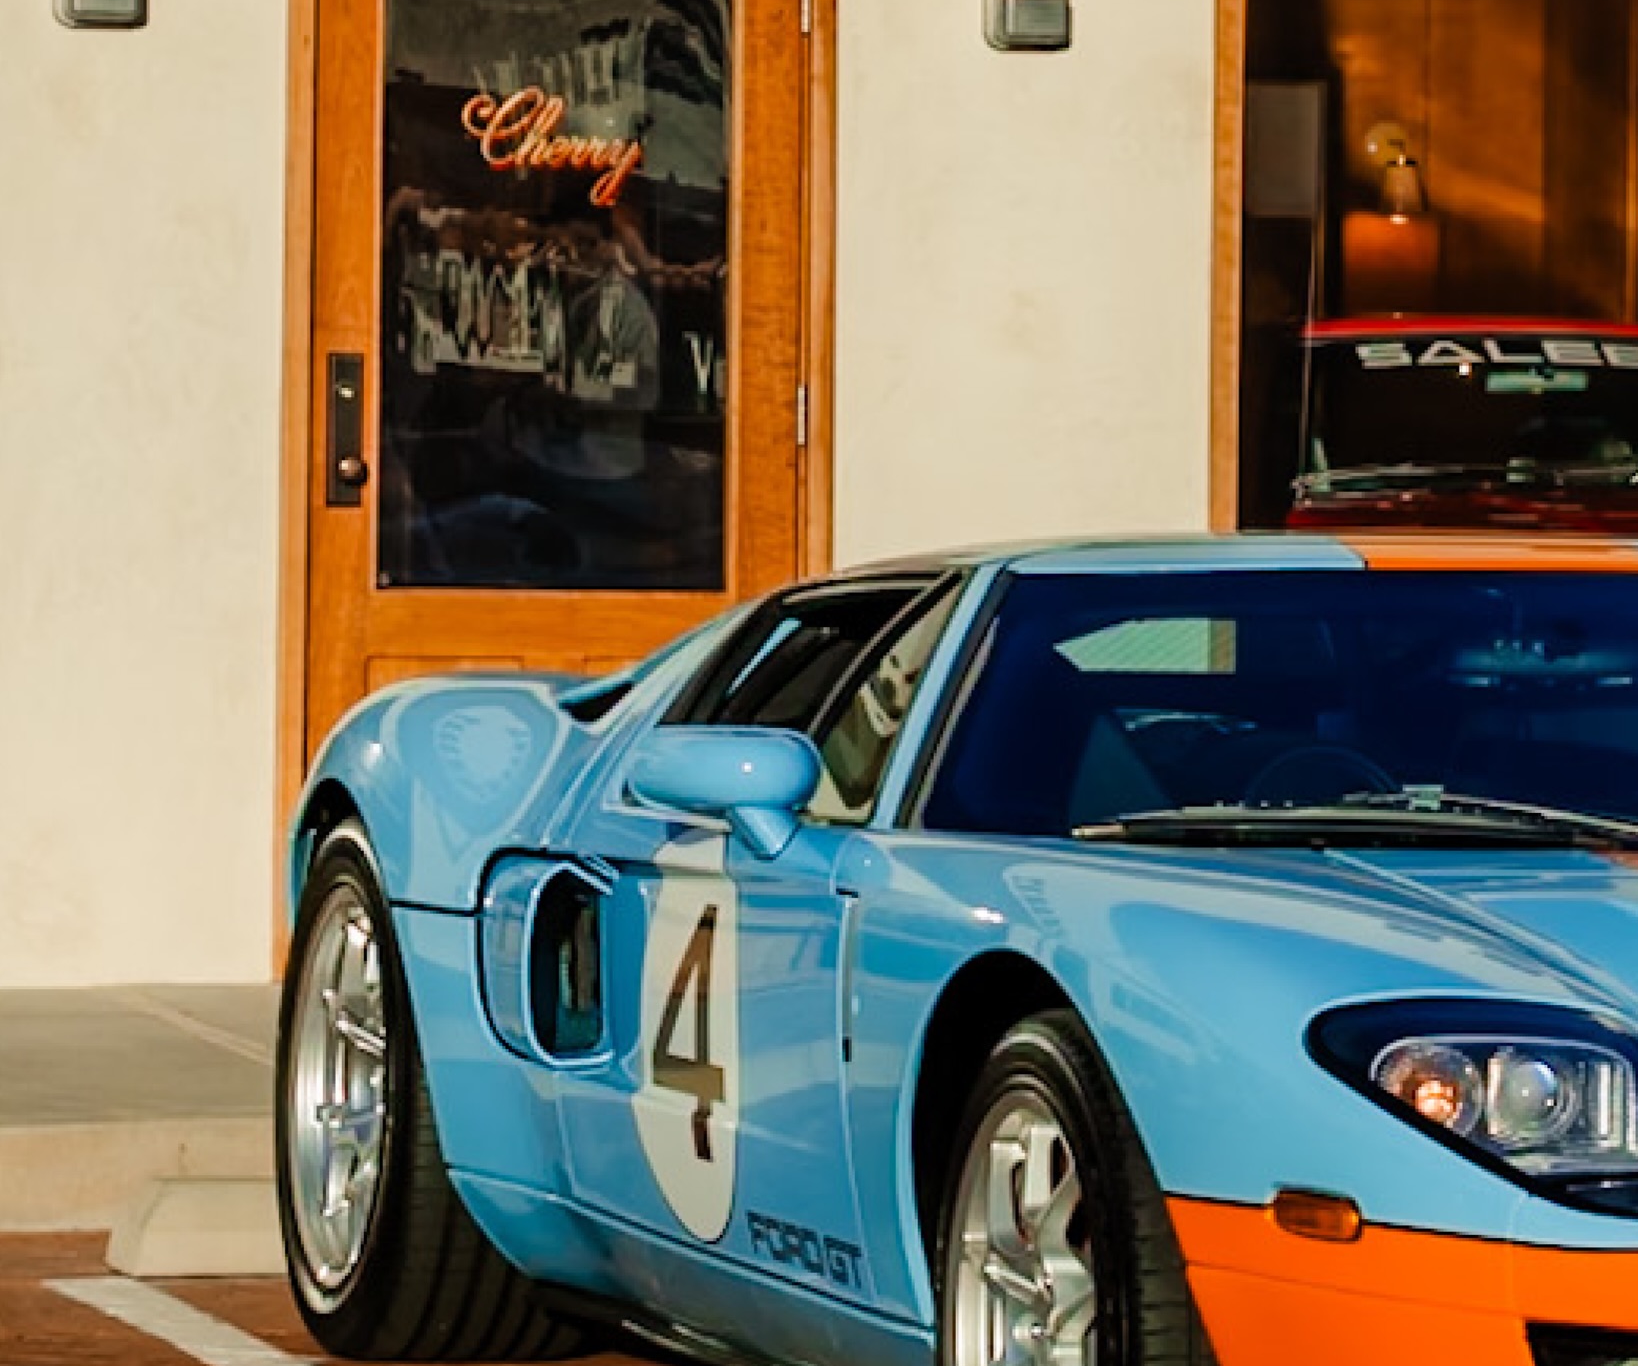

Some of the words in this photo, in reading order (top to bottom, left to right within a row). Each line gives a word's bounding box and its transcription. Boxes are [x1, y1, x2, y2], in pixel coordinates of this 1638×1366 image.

[461, 85, 641, 205] Cherry
[653, 905, 725, 1162] 4
[746, 1211, 823, 1275] FORD
[823, 1235, 861, 1288] GT
